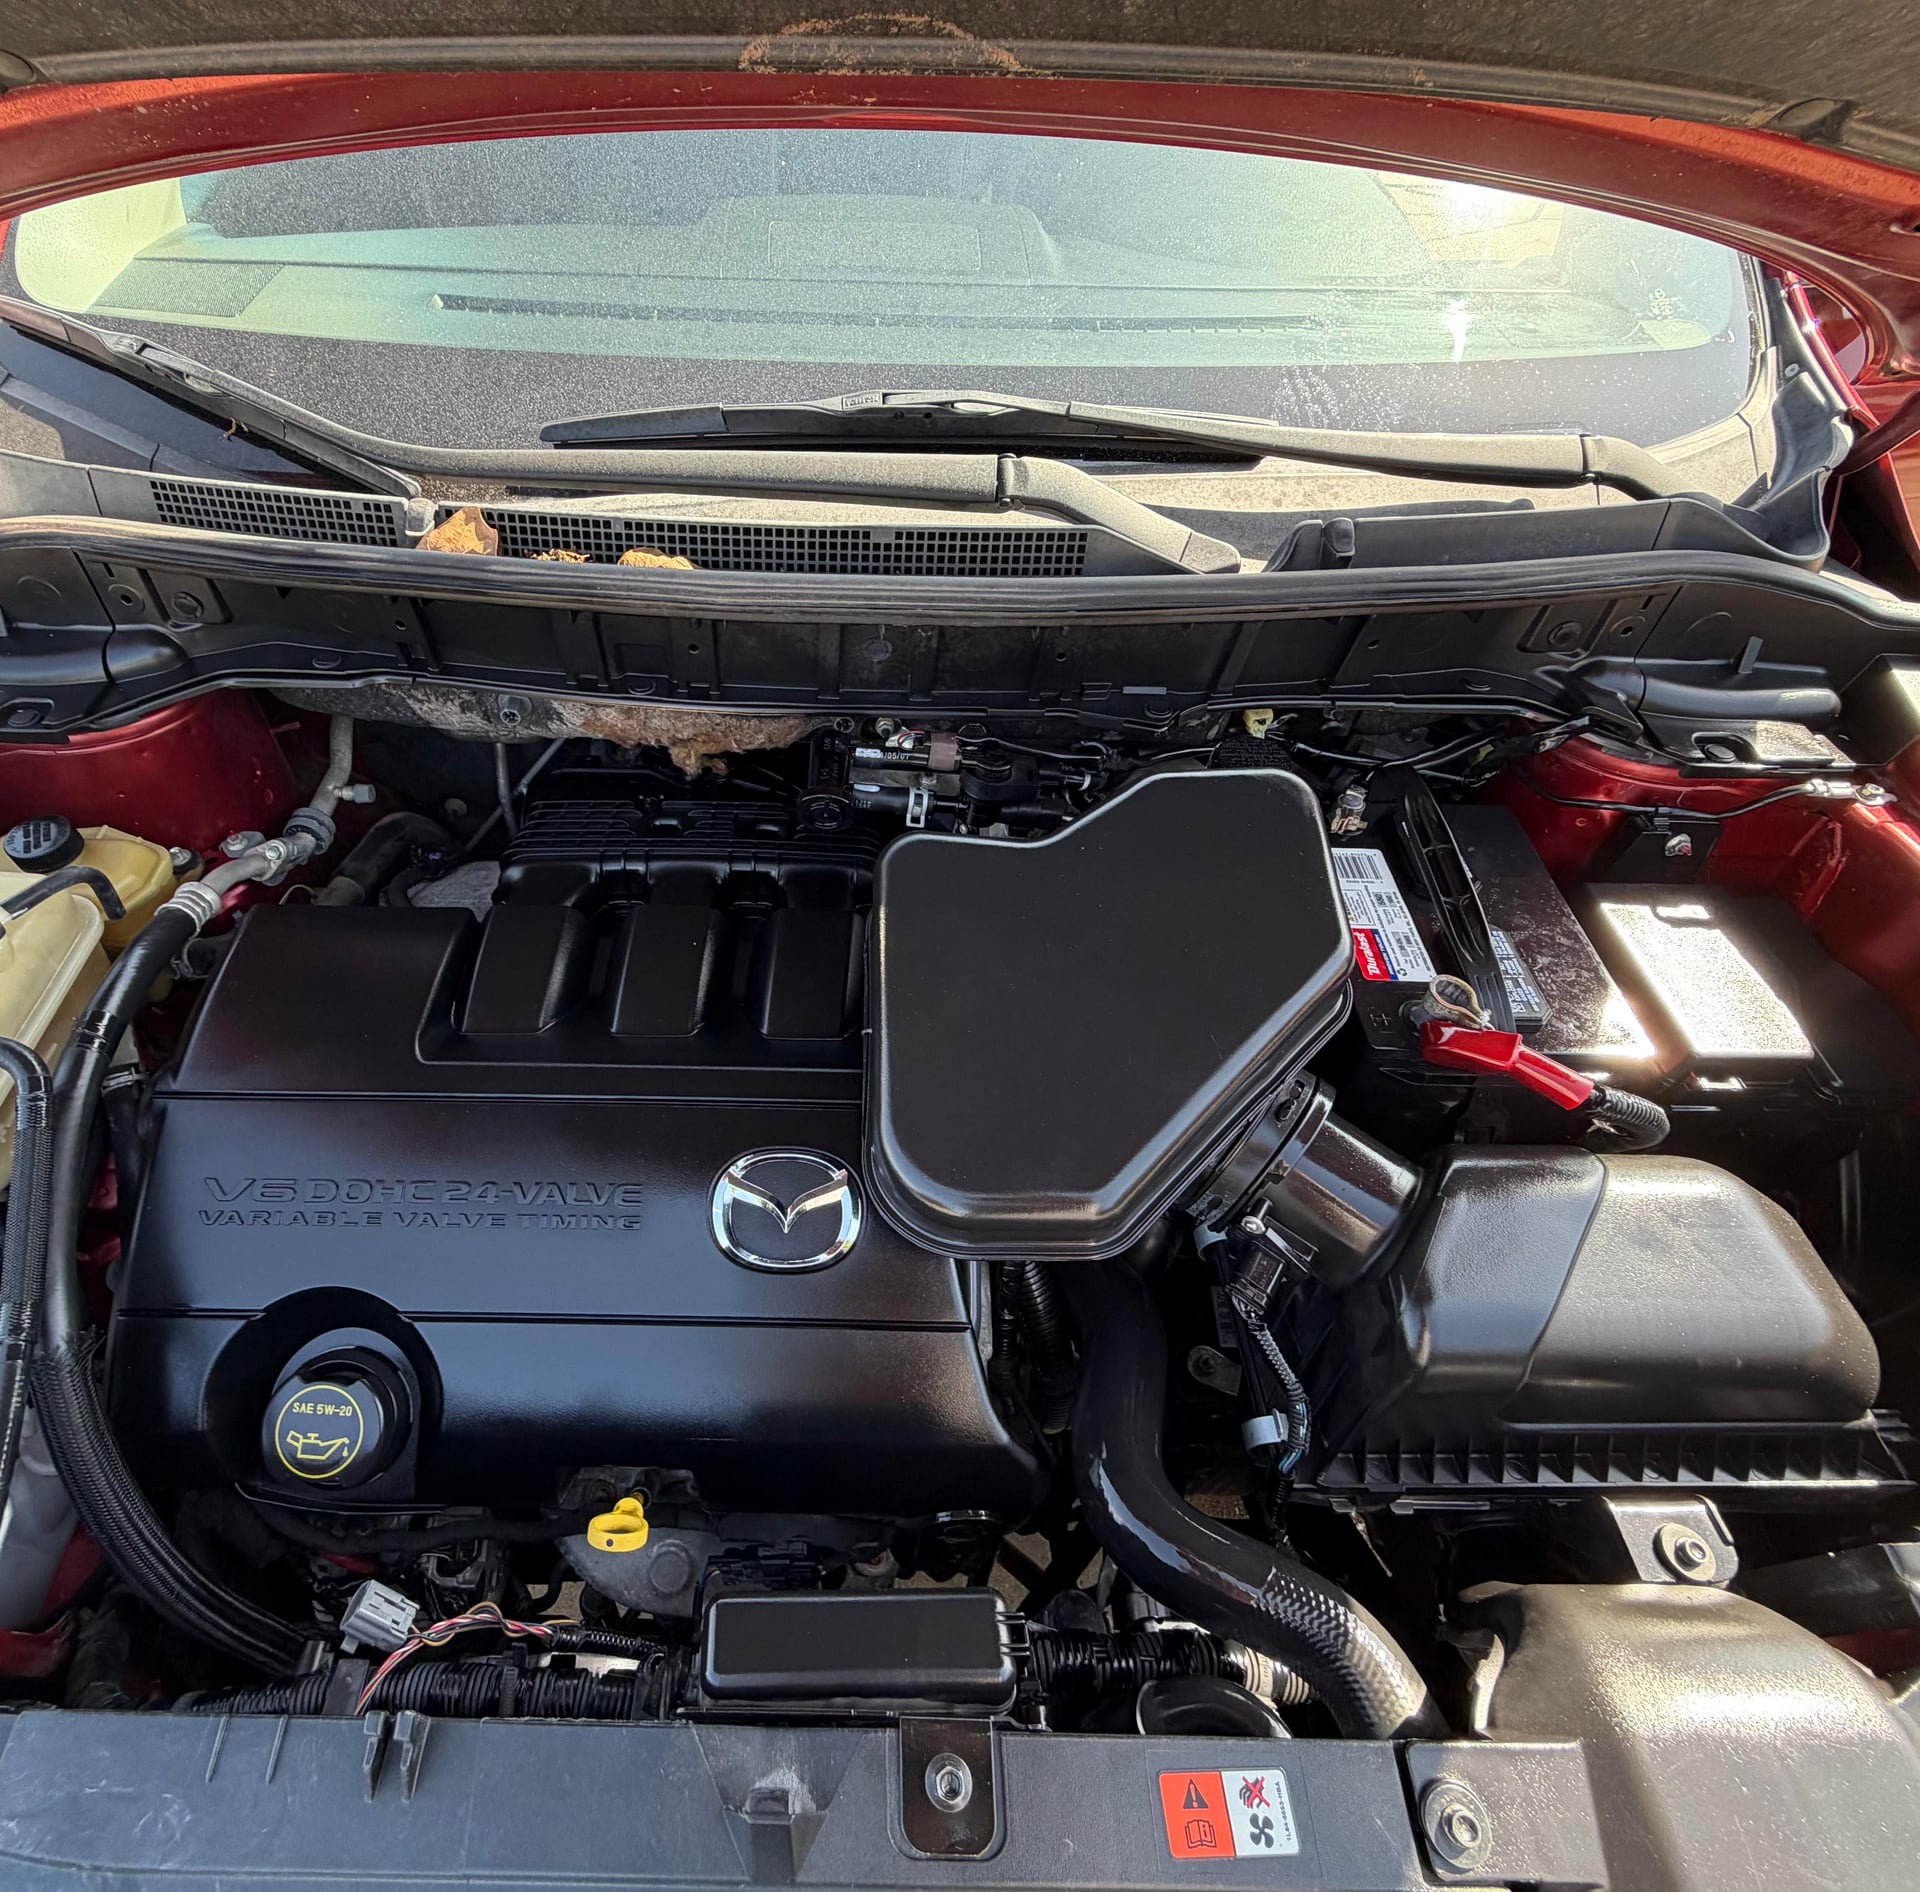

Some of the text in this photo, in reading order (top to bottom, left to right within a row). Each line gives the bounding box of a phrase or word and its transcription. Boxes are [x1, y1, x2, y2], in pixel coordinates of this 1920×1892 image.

[1354, 931, 1380, 976] Duralast
[203, 1177, 644, 1208] V6 DOHC 24-VALVE
[199, 1209, 643, 1231] VARIABLE VALVE TIMING
[292, 1402, 353, 1416] SAE 5W-20
